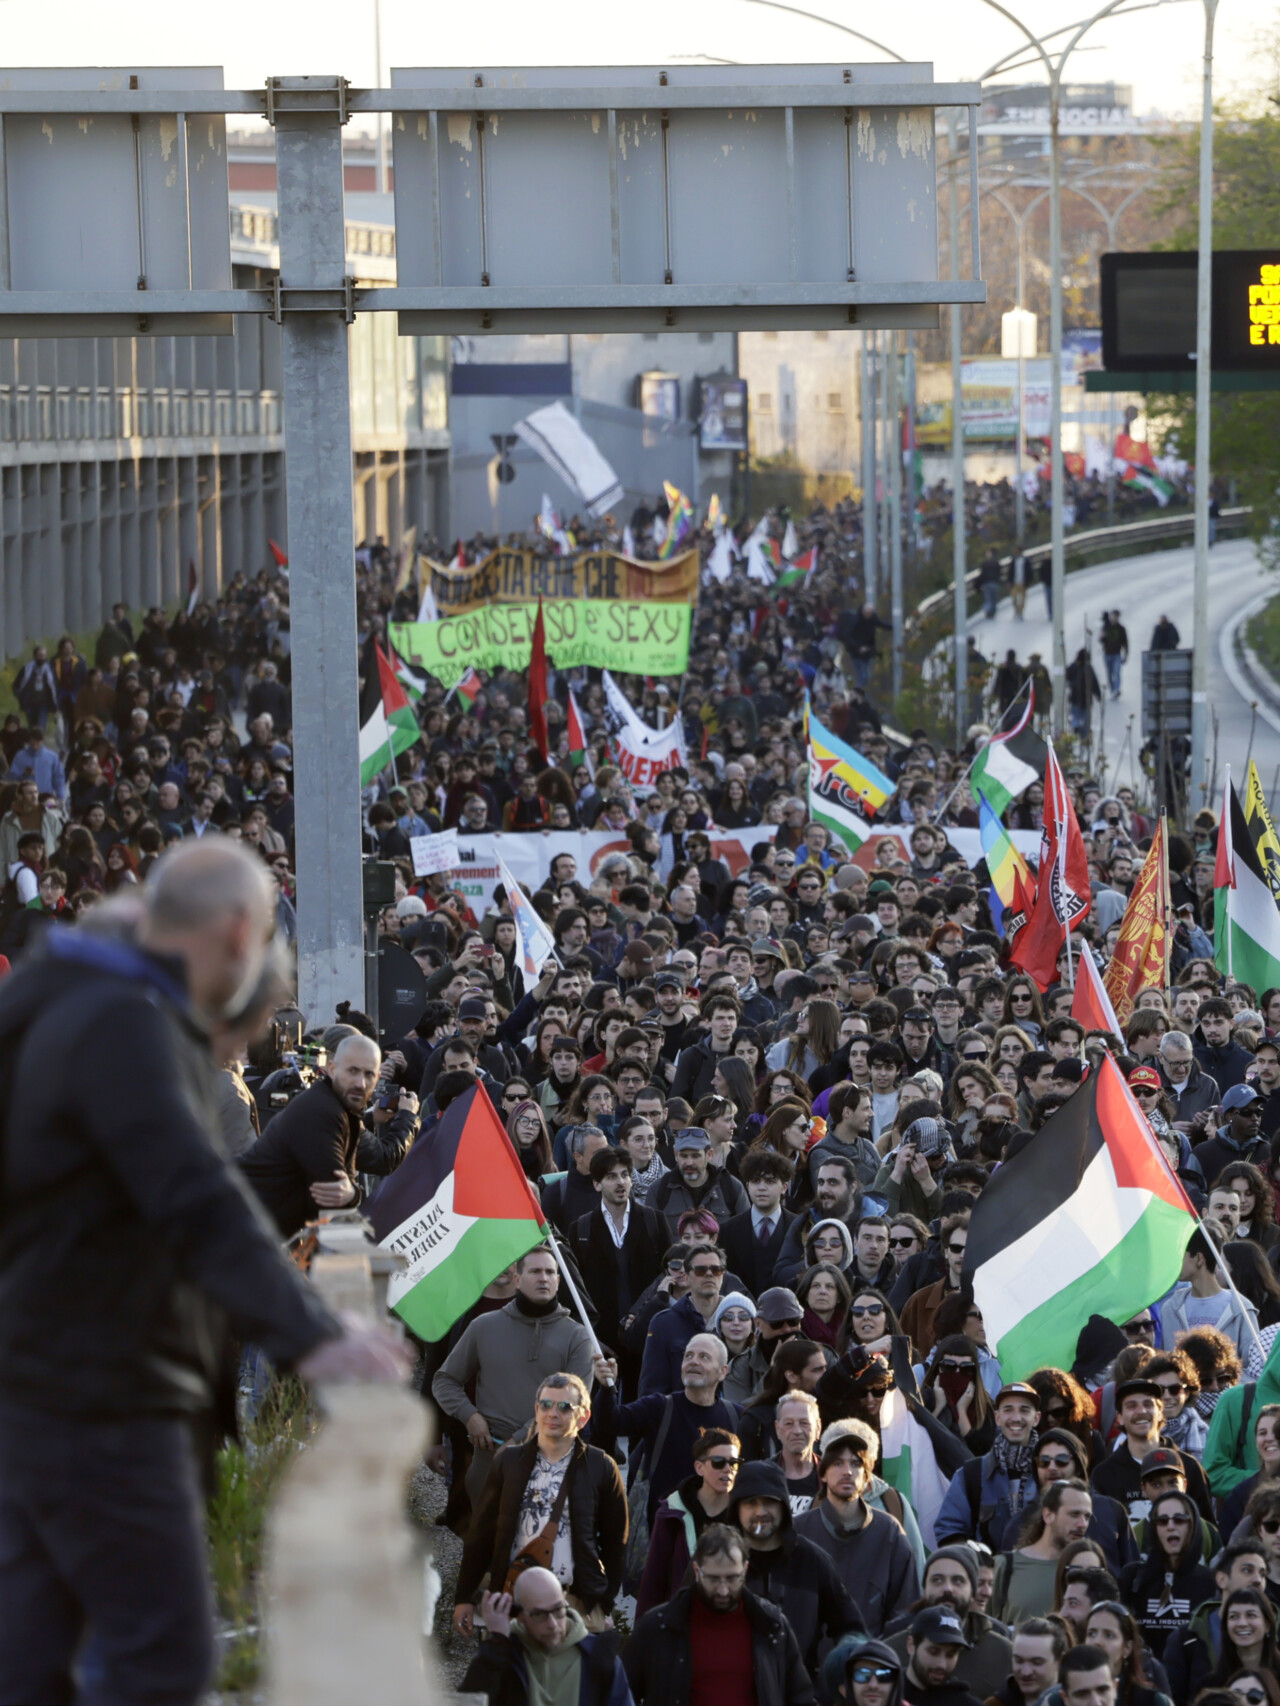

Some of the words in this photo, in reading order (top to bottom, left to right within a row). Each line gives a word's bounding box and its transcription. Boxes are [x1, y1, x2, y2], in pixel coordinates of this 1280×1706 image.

[1249, 325, 1265, 345] E
[585, 556, 620, 599] CHE
[606, 602, 682, 645] SEXY
[449, 864, 501, 880] ovement
